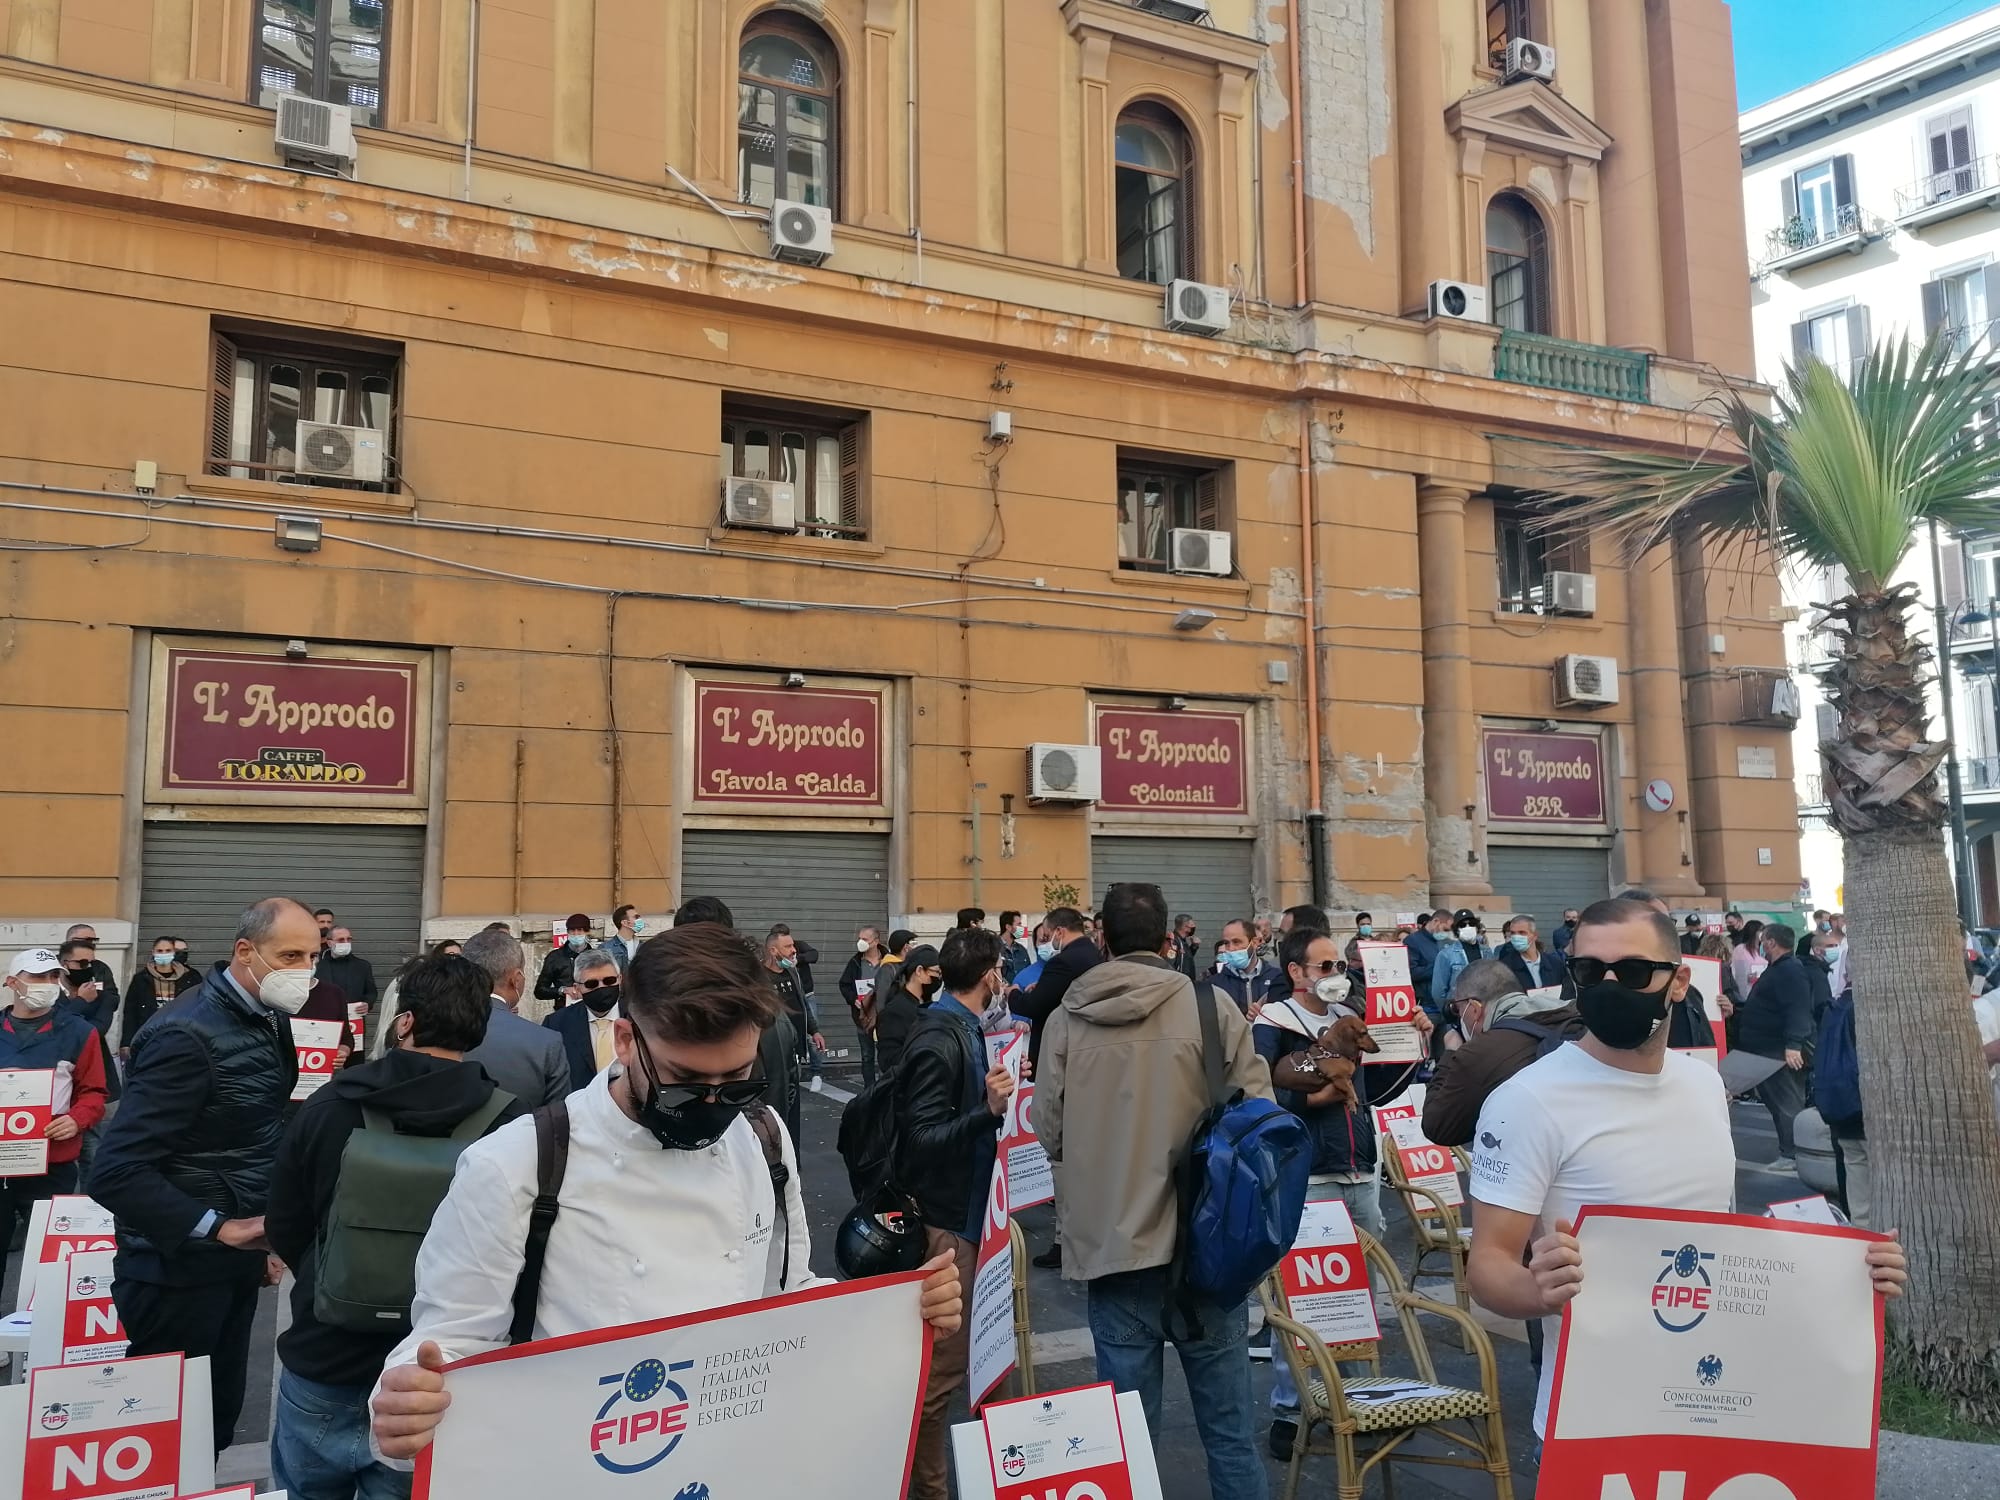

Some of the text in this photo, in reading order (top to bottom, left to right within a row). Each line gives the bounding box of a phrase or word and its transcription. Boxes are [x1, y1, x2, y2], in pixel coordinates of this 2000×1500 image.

[193, 681, 395, 734] L' Approdo
[712, 706, 865, 752] L' Approdo
[1109, 727, 1231, 767] L' Approdo
[219, 760, 366, 783] TORALDO
[1494, 748, 1592, 783] L' Approdo
[711, 768, 866, 795] Tavola Calda
[1129, 783, 1215, 804] Coloniali
[1524, 796, 1569, 818] BAR
[1376, 991, 1410, 1019] NO
[1408, 1149, 1444, 1173] NO
[1294, 1252, 1351, 1287] NO
[1722, 1255, 1796, 1273] FEDERAZIONE
[1720, 1270, 1771, 1286] ITALIANA
[1651, 1284, 1712, 1310] FIPE
[1718, 1285, 1769, 1301] PUBBLICI
[1717, 1300, 1766, 1316] ESERCIZI
[704, 1336, 807, 1370] FEDERAZIONE
[702, 1362, 771, 1388] ITALIANA
[700, 1380, 768, 1407] PUBBLICI
[41, 1414, 70, 1425] FIPE
[697, 1398, 764, 1427] ESERCIZI
[590, 1402, 689, 1452] FIPE
[52, 1435, 153, 1491] NO
[1002, 1458, 1026, 1471] FIPE
